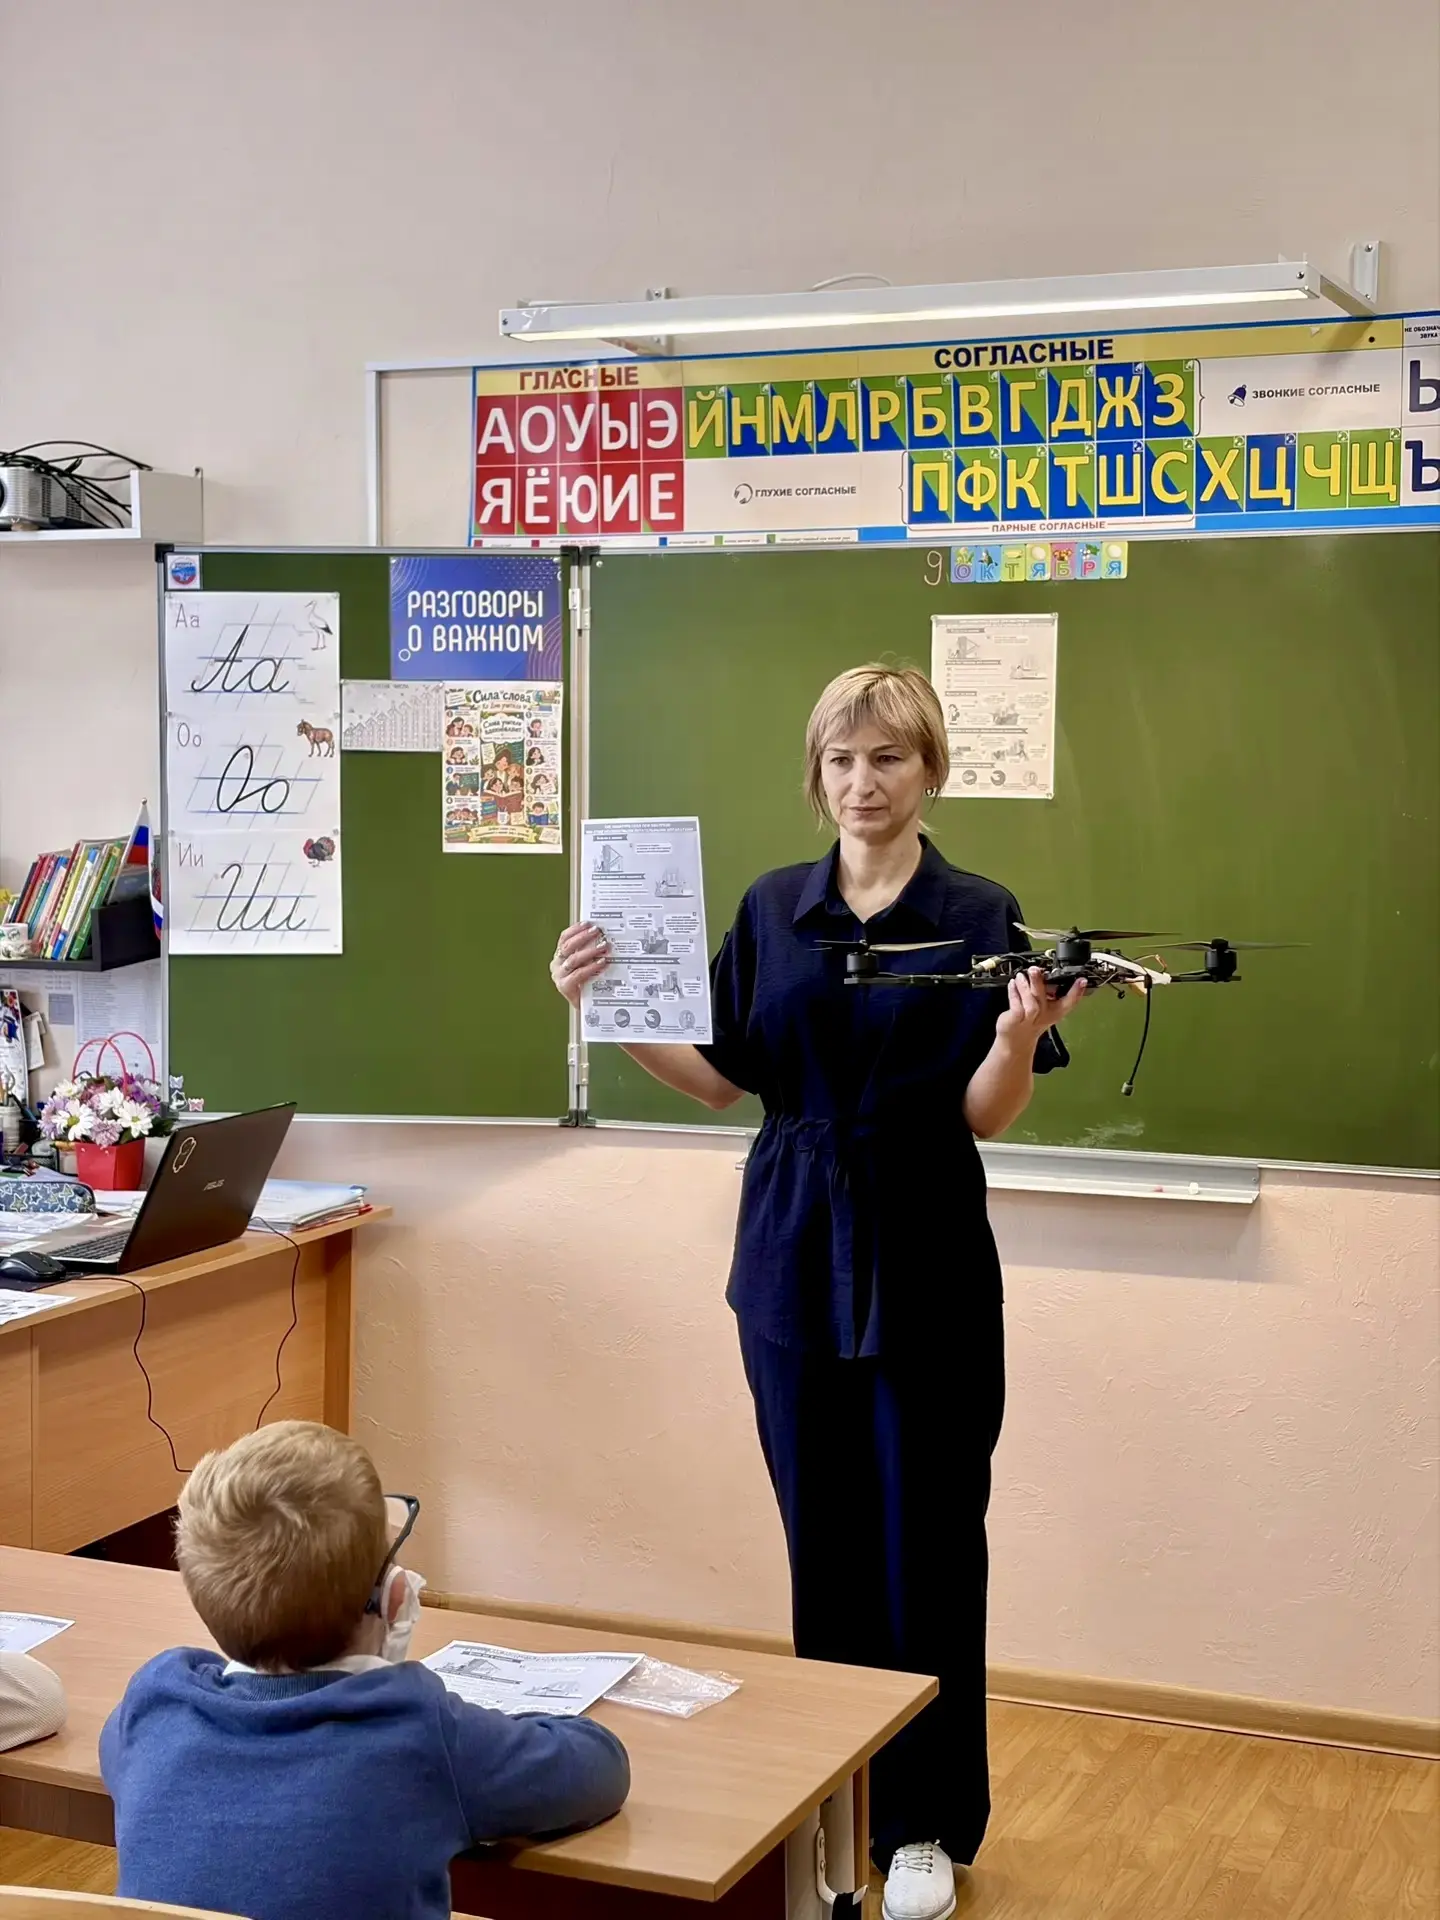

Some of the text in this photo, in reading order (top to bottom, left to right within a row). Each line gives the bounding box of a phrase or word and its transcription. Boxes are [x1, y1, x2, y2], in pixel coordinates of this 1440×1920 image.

[934, 339, 1114, 369] СОГЛАСНЫЕ
[519, 366, 639, 391] ГЛАСНЫЕ
[1252, 384, 1381, 399] ЗВОНКИЕ СОГЛАСНЫЕ
[755, 484, 857, 498] ГЛУХИЕ СОГЛАСНЫЕ
[991, 521, 1106, 533] ПАРНЫЕ СОГЛАСНЫЕ
[924, 550, 943, 586] 9
[175, 603, 200, 628] Аа
[407, 590, 543, 618] РАЗГОВОРЫ
[408, 624, 543, 652] О ВАЖНОМ
[472, 689, 531, 704] Сила слова
[177, 722, 202, 747] Оо
[178, 843, 204, 868] Ии
